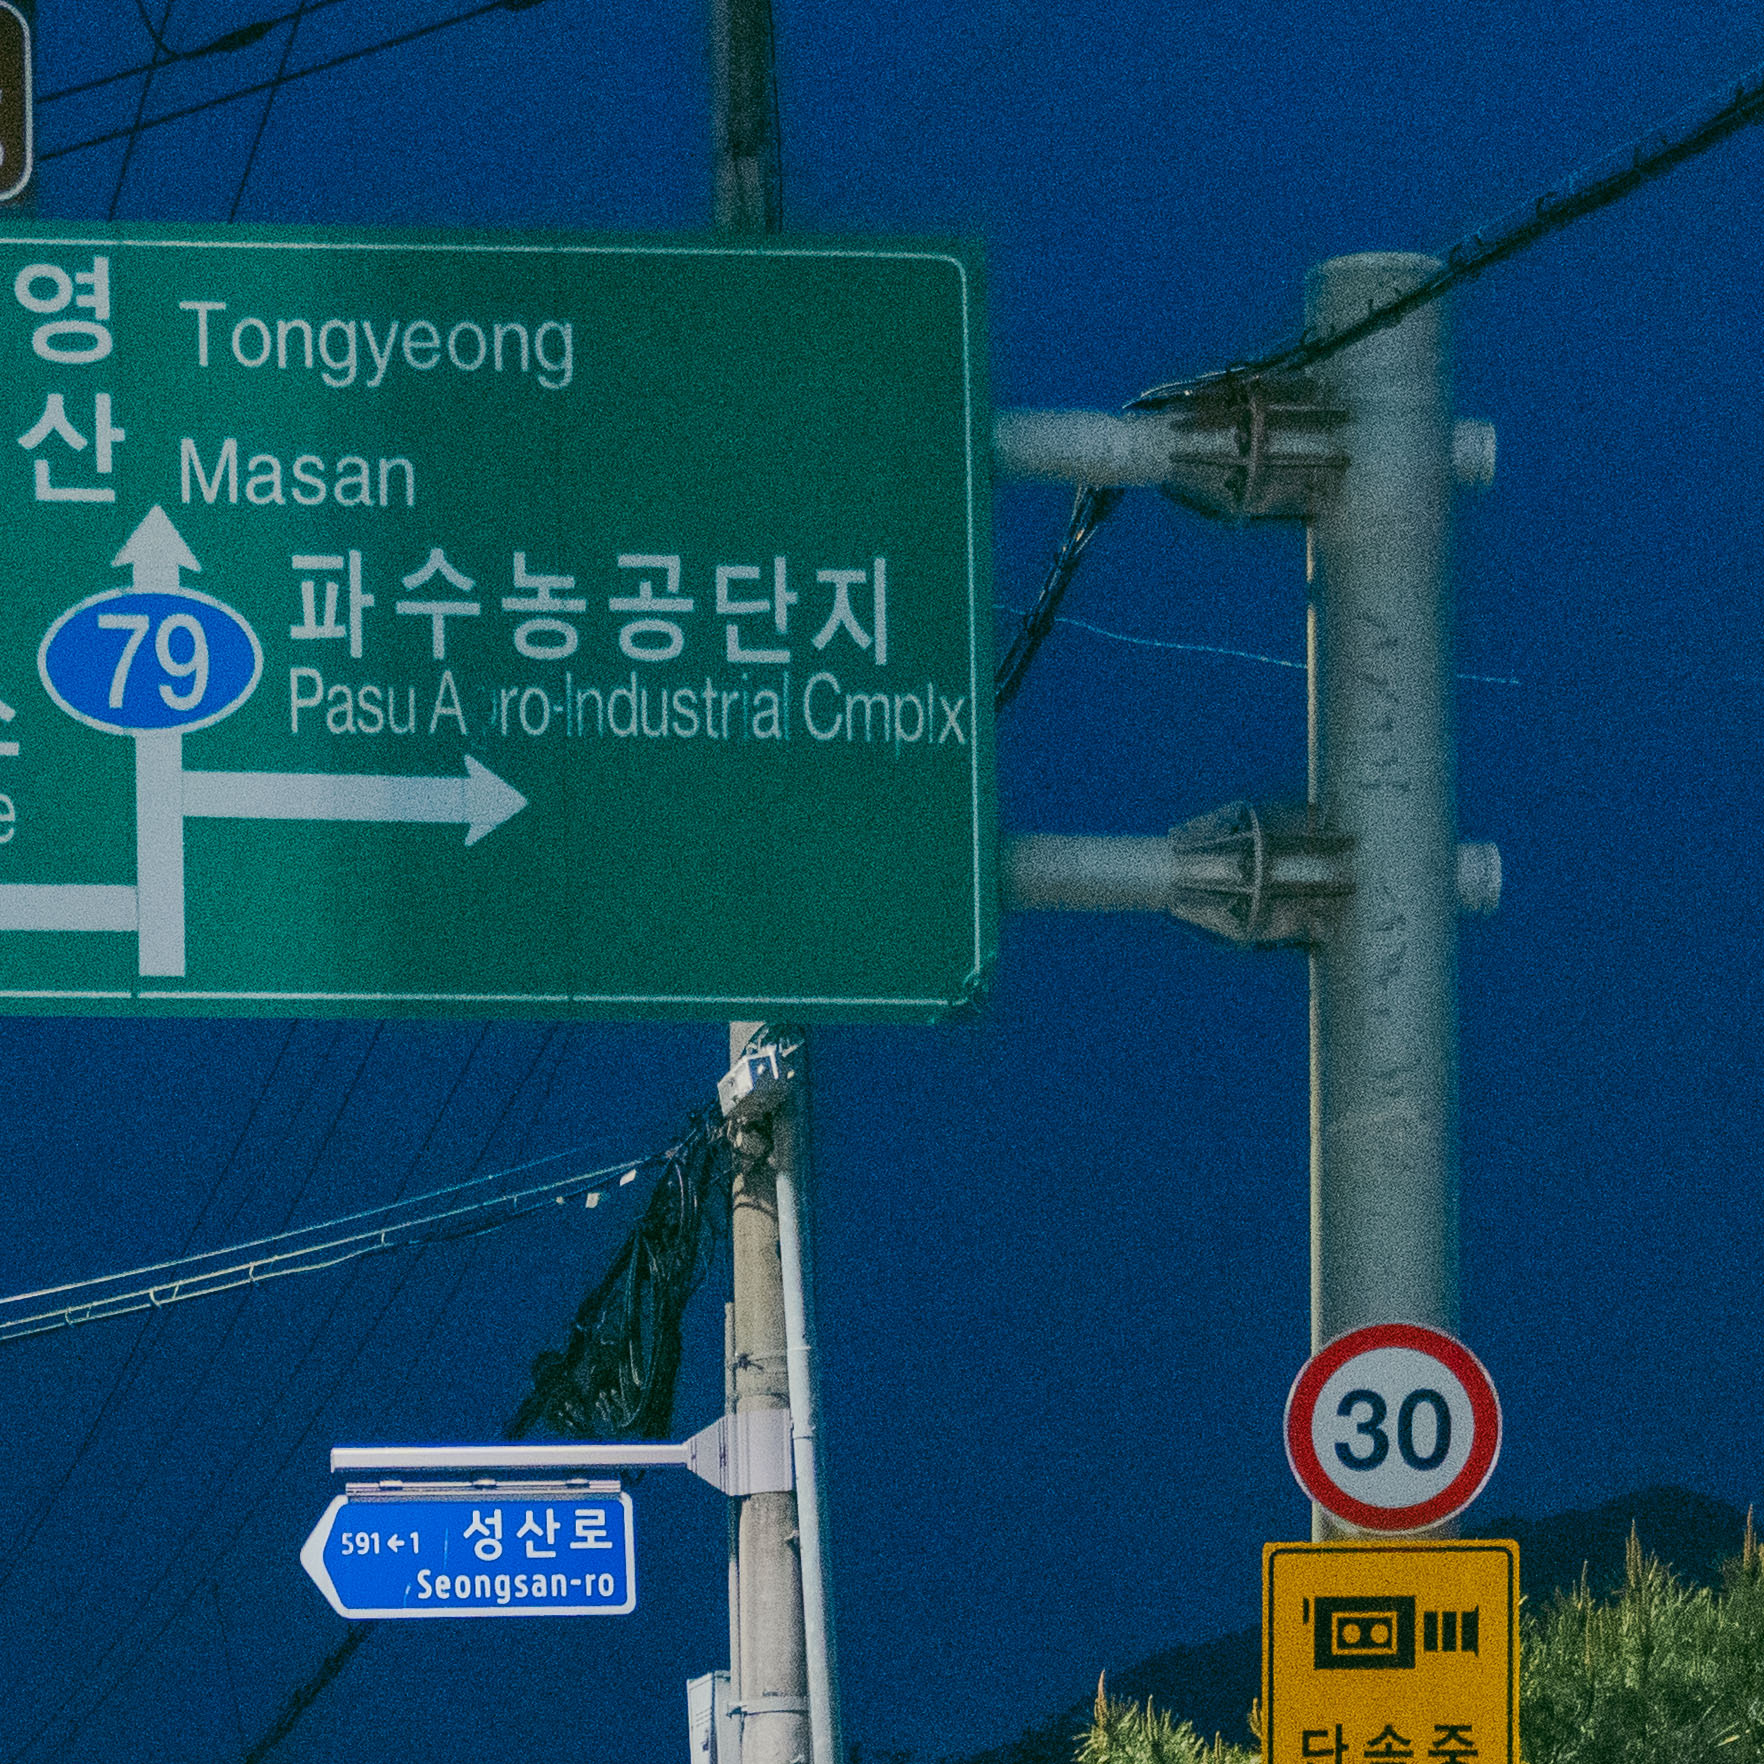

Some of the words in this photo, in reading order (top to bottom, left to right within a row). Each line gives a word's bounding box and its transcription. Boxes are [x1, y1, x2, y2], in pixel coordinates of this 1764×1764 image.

[179, 300, 575, 389] Tongyeong
[180, 438, 416, 507] Masan
[289, 548, 889, 666] 파수농공단지
[96, 613, 209, 711] 79
[290, 667, 415, 735] Pasu
[429, 670, 789, 744] Aro-Industrial
[803, 671, 966, 760] Cmplx
[1334, 1388, 1452, 1472] 30
[462, 1507, 614, 1561] 성산로
[416, 1568, 615, 1604] Seongsan-ro
